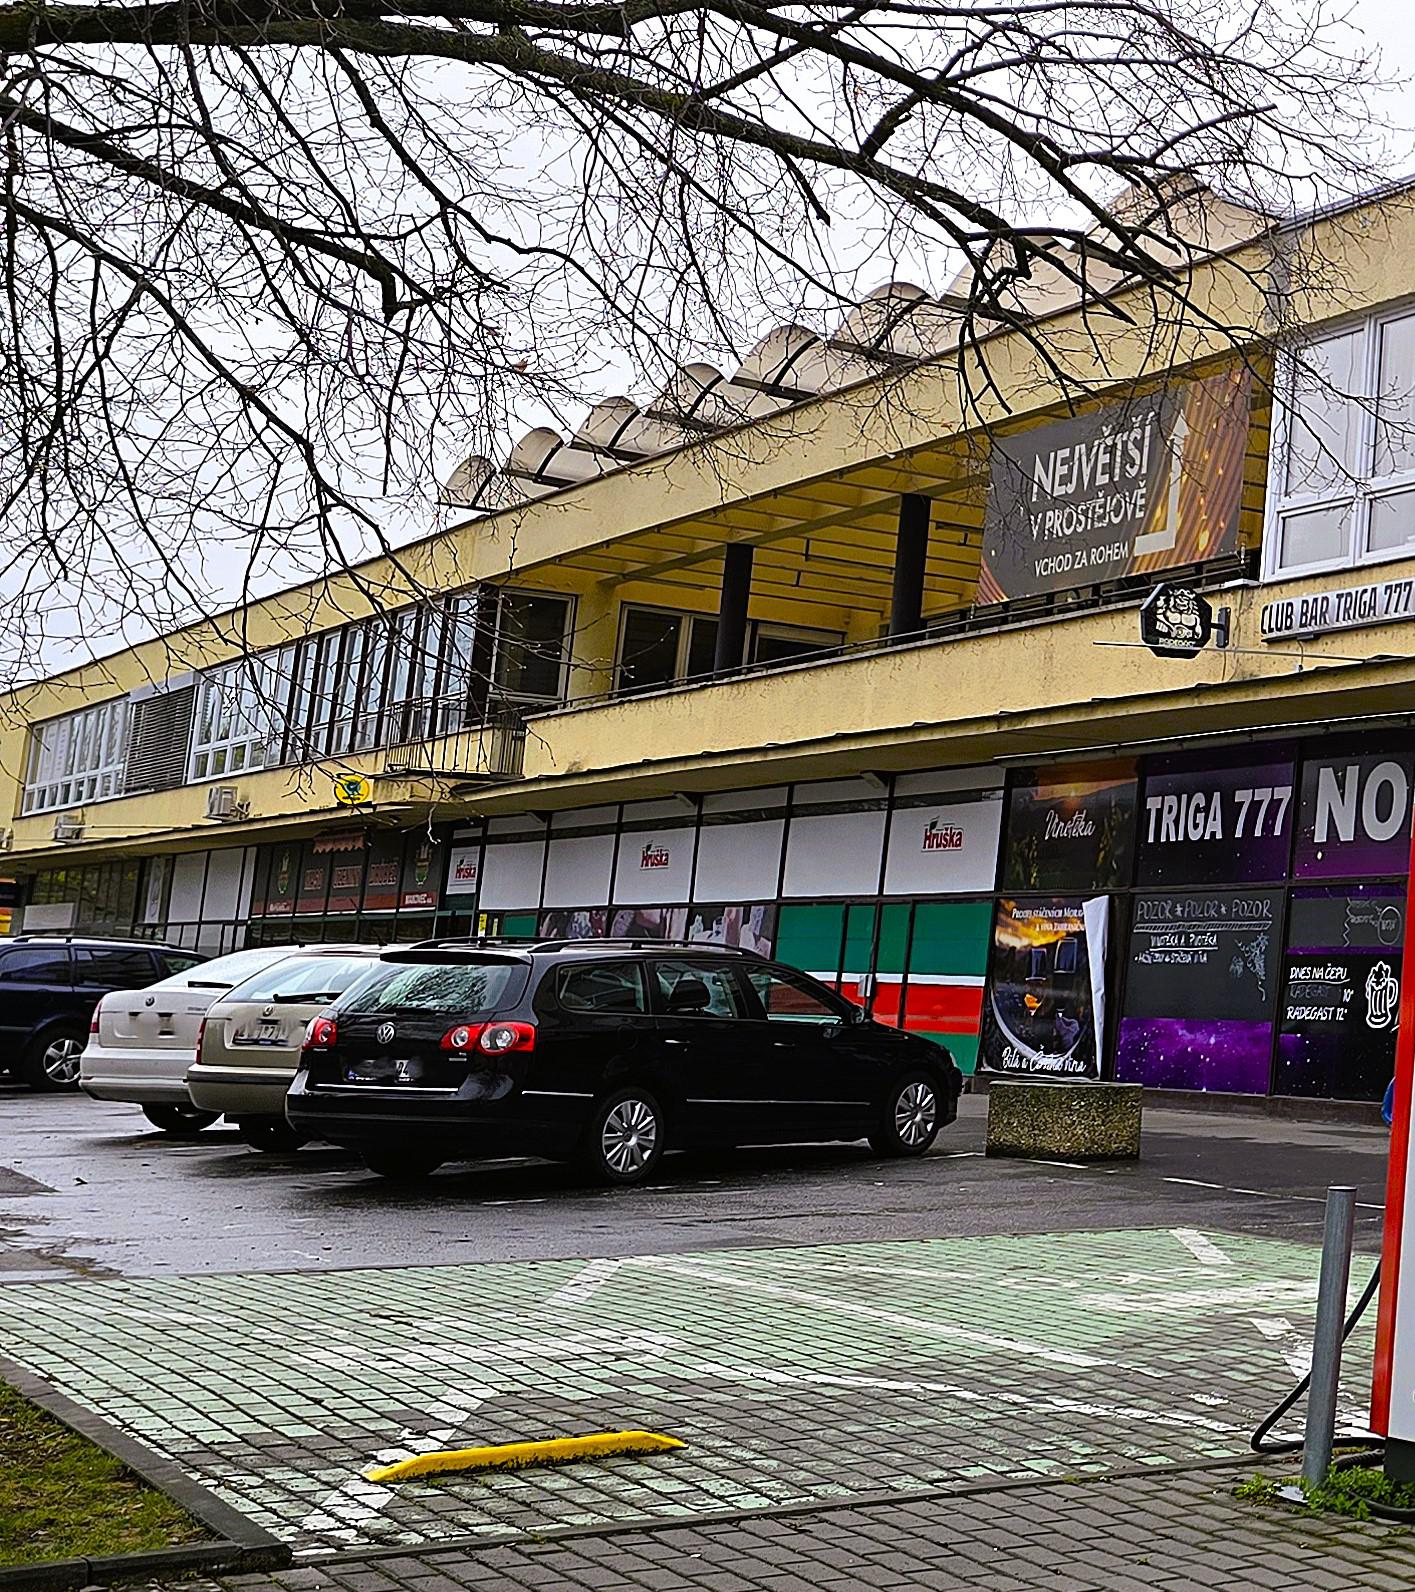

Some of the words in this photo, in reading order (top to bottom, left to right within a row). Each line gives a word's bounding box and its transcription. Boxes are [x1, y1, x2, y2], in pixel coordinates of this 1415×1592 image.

[1031, 410, 1156, 502] NEJVĚTŠÍ
[1030, 513, 1044, 542] V
[1043, 480, 1149, 541] PROSTĚJOVĚ
[1033, 555, 1073, 578] VCHOD
[1073, 551, 1089, 569] ZA
[1089, 541, 1130, 566] ROHEM
[1260, 600, 1294, 635] CLUB
[1299, 596, 1330, 629] BAR
[1334, 586, 1378, 624] TRIGA
[1382, 580, 1414, 616] 777
[1145, 791, 1223, 844] TRIGA
[1234, 785, 1293, 840] 777
[922, 826, 963, 850] Hruška
[1231, 898, 1272, 918] POZOR
[1290, 966, 1311, 980] DNES
[1311, 966, 1324, 980] NA
[1324, 963, 1348, 980] ČEPU
[1286, 1006, 1335, 1020] RADEGAST
